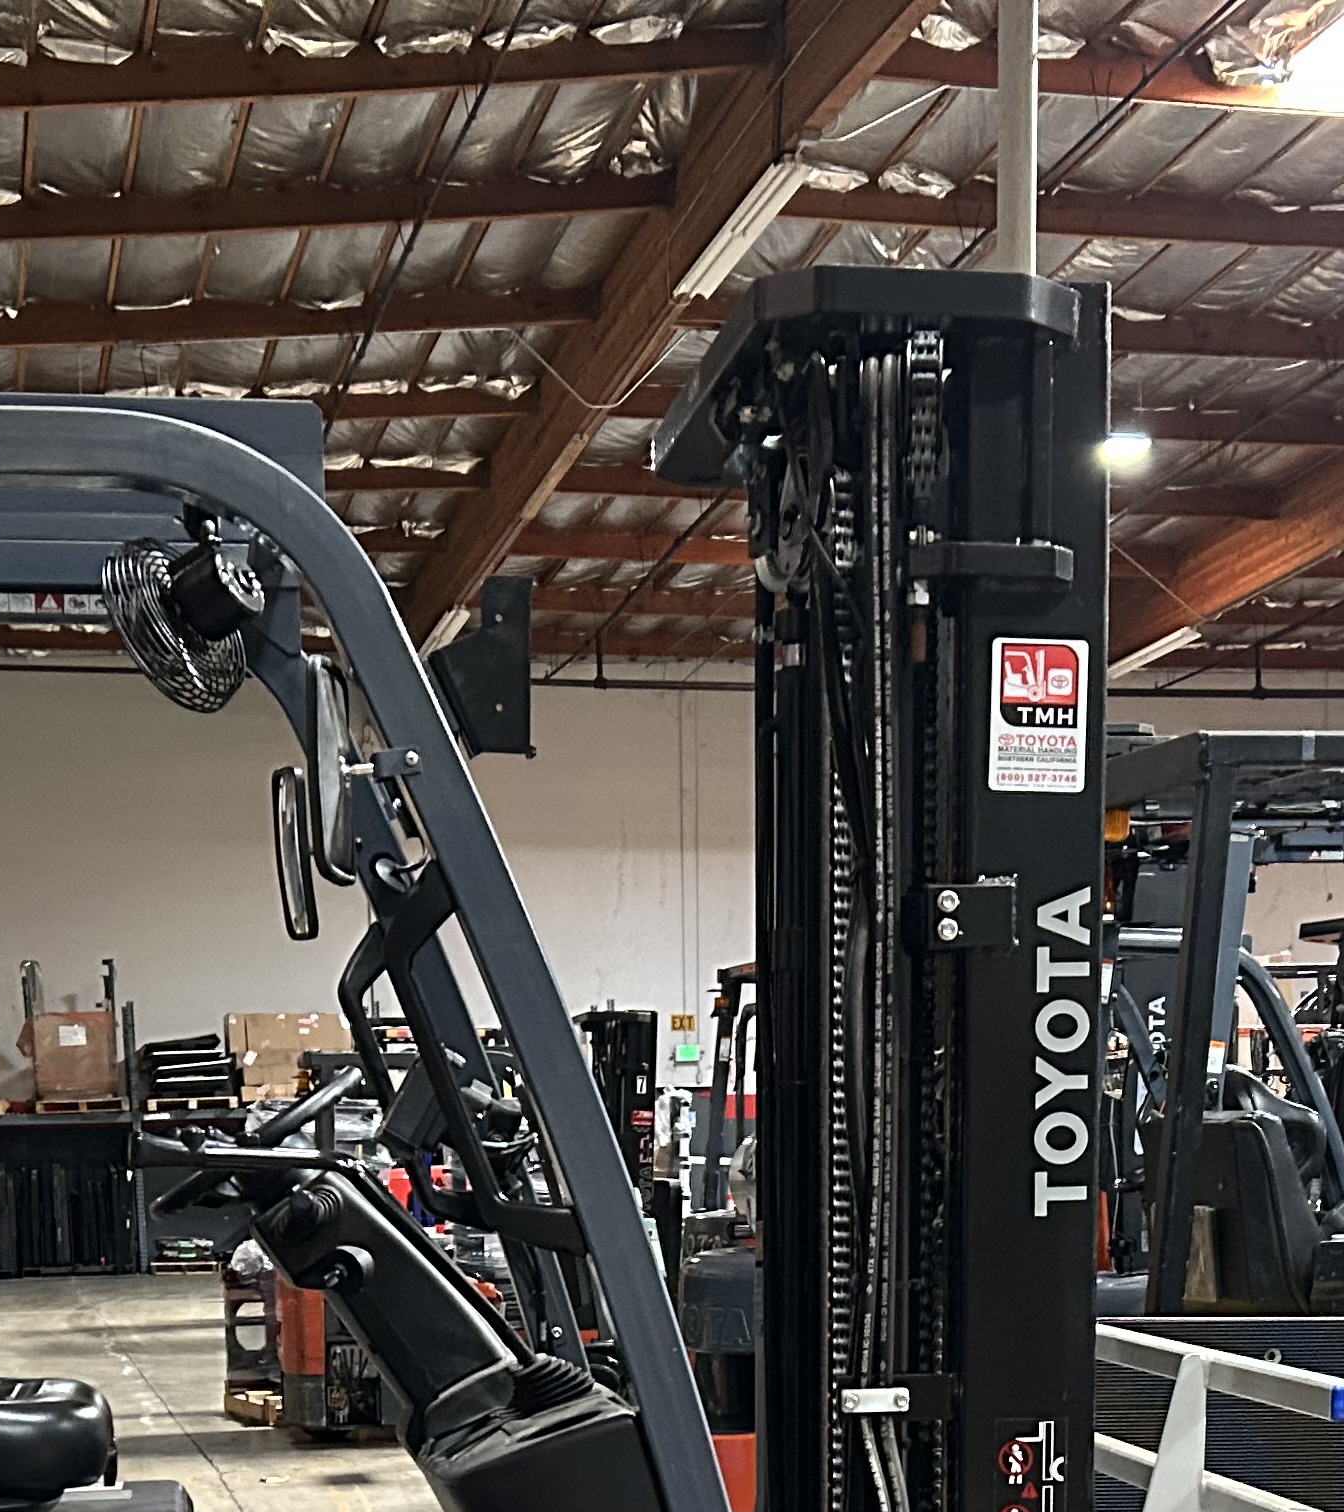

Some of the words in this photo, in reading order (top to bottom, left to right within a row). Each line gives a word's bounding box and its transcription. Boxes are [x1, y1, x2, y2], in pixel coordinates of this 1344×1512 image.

[1017, 706, 1074, 726] TMH
[1016, 733, 1077, 748] TOYOTA
[672, 1015, 695, 1030] EXT
[1034, 886, 1091, 1217] TOYOTA
